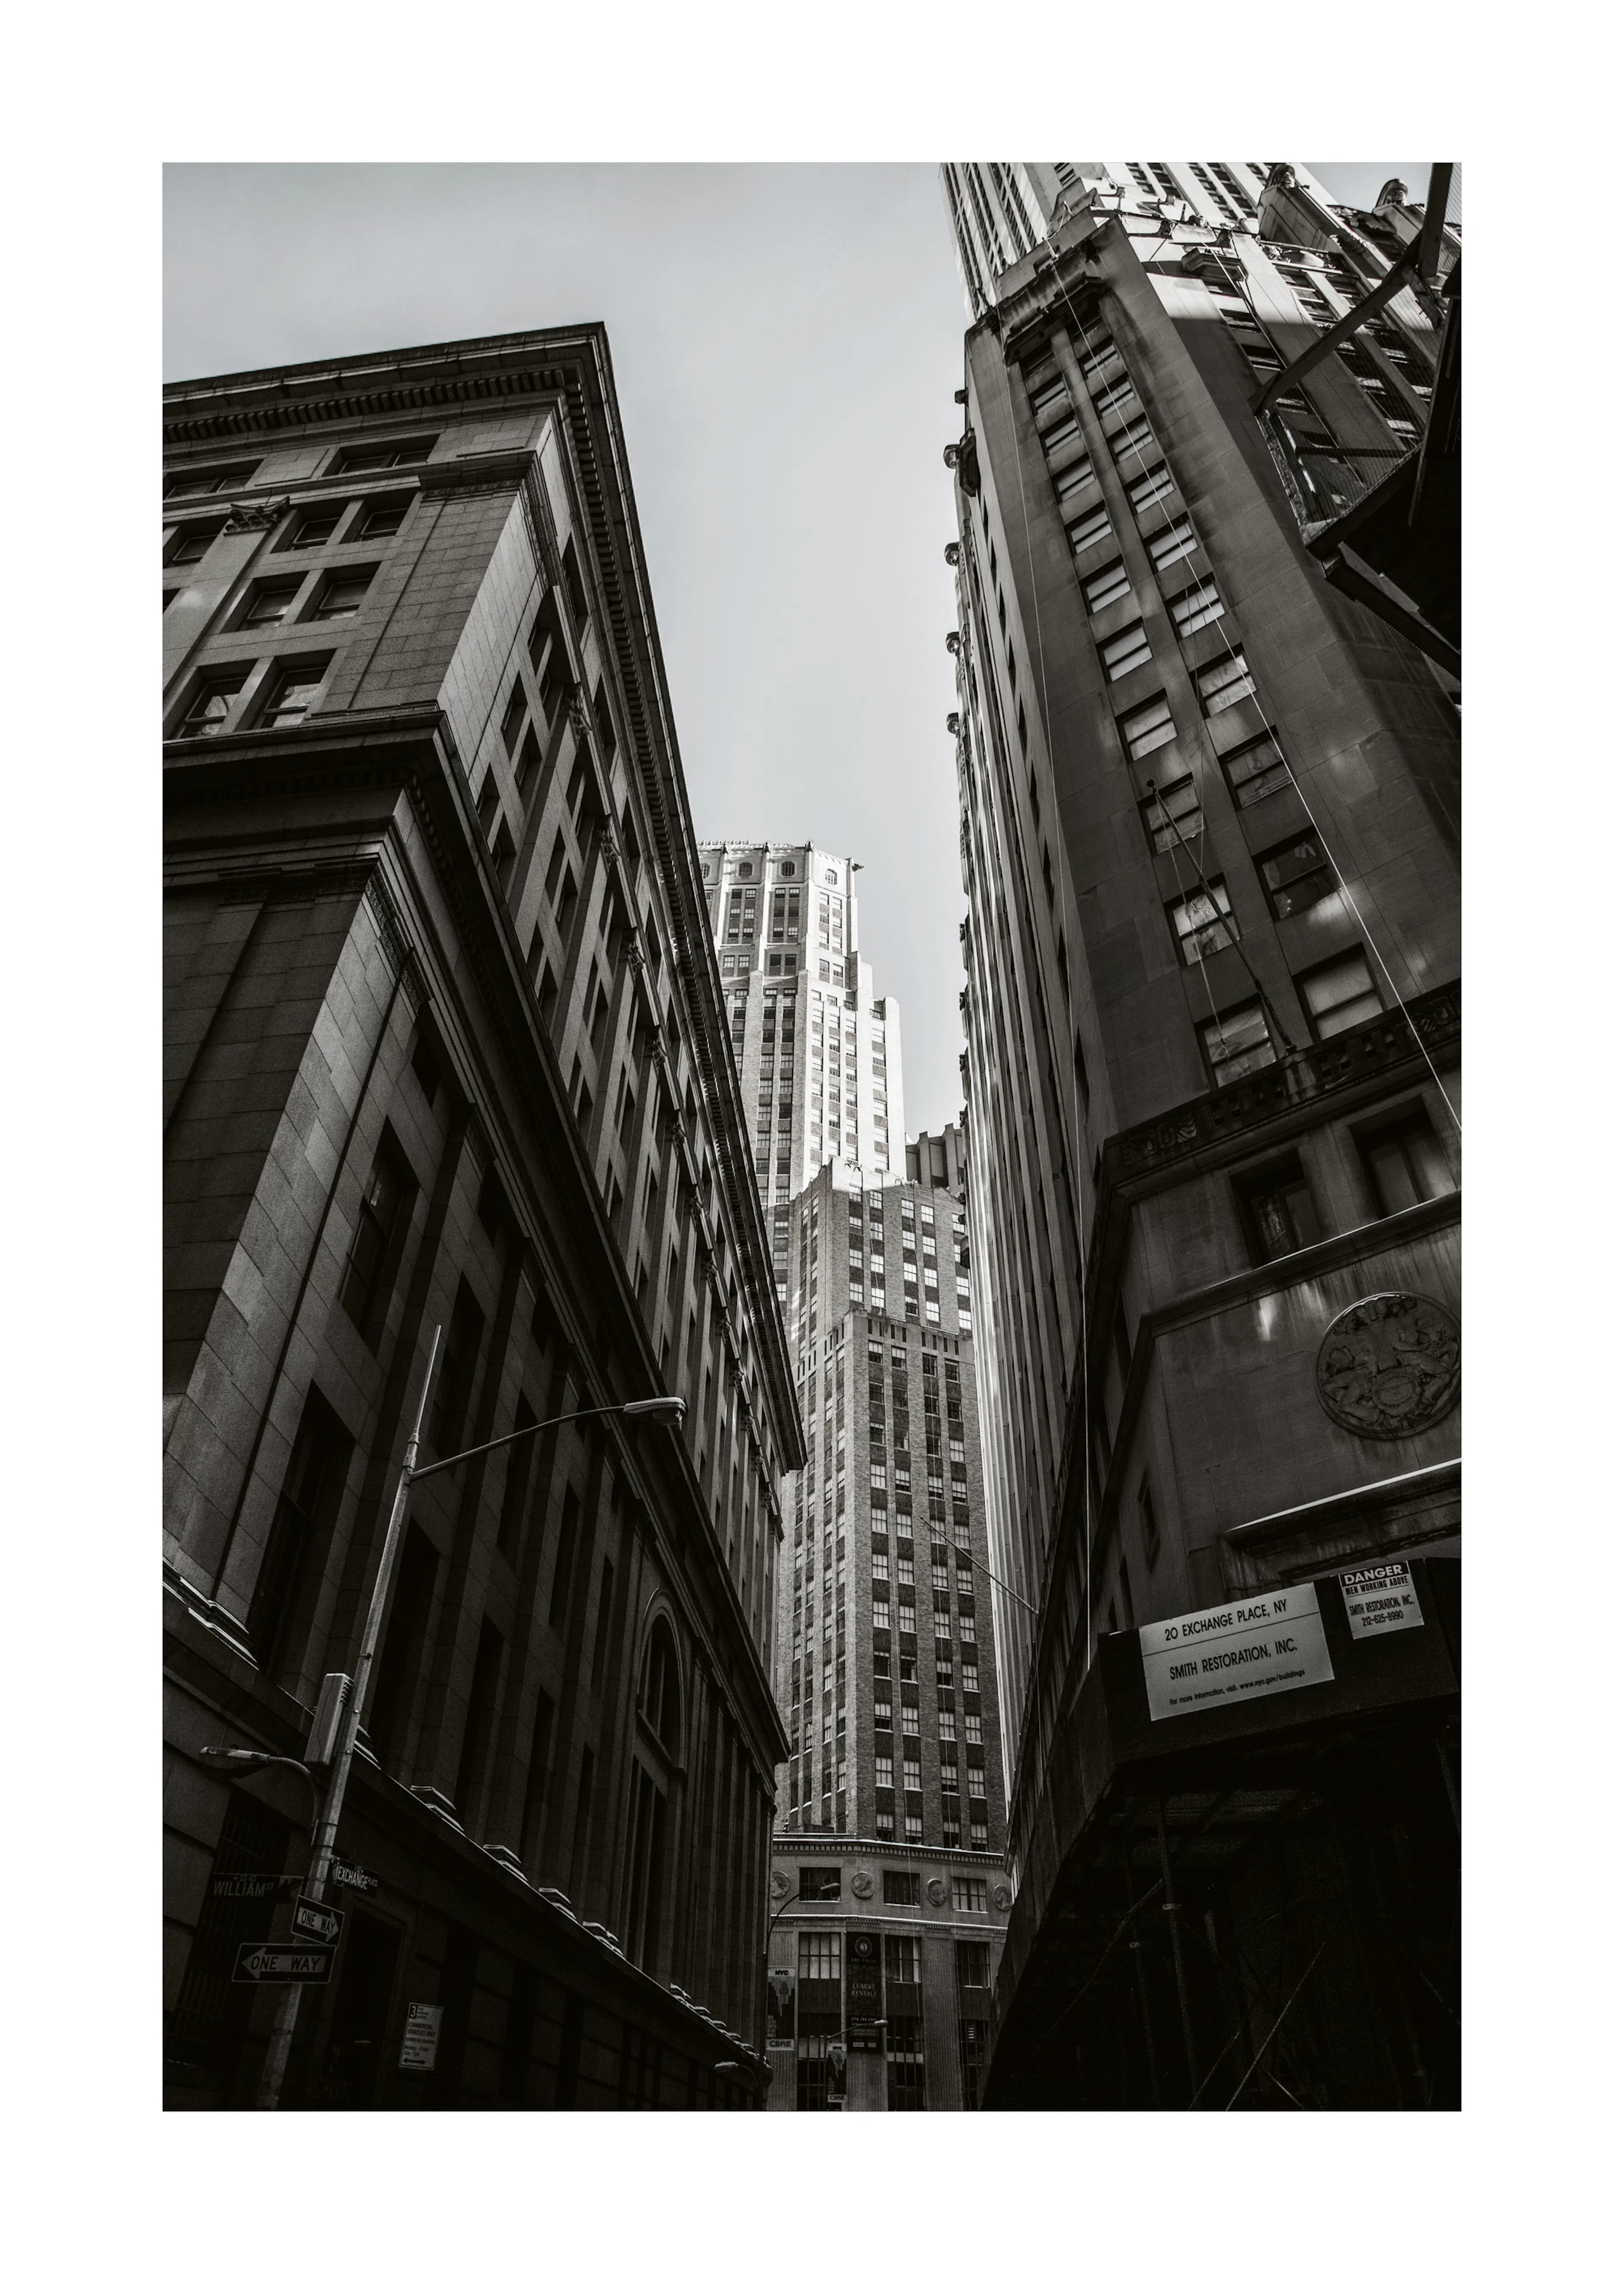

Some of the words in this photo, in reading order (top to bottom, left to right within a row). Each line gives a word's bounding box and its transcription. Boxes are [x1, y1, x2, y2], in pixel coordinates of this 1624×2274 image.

[1344, 1564, 1402, 1585] DANGER
[1345, 1585, 1359, 1596] MEN
[1360, 1579, 1388, 1592] WORKING
[1389, 1576, 1409, 1587] ABOVE
[1349, 1603, 1365, 1616] SMITH
[1401, 1594, 1414, 1606] INC.
[1165, 1627, 1178, 1641] 20
[1182, 1613, 1233, 1637] EXCHANGE
[1237, 1604, 1270, 1623] PLACE,
[1273, 1599, 1287, 1613] NY
[1361, 1609, 1404, 1626] 212-625-8990
[1169, 1662, 1198, 1680] SMITH
[1202, 1644, 1271, 1673] RESTORATION,
[1275, 1638, 1298, 1655] INC.
[1180, 1695, 1193, 1704] more
[1239, 1670, 1305, 1690] www.nyc.gov/buildings
[337, 1865, 368, 1890] EXCHANGE
[367, 1877, 379, 1887] PLACE
[214, 1881, 266, 1897] WILLIAM
[266, 1882, 275, 1891] ST
[301, 1910, 316, 1928] ONE
[321, 1917, 336, 1934] WAY
[251, 1955, 278, 1970] ONE
[291, 1956, 320, 1971] WAY
[410, 2005, 417, 2017] 3
